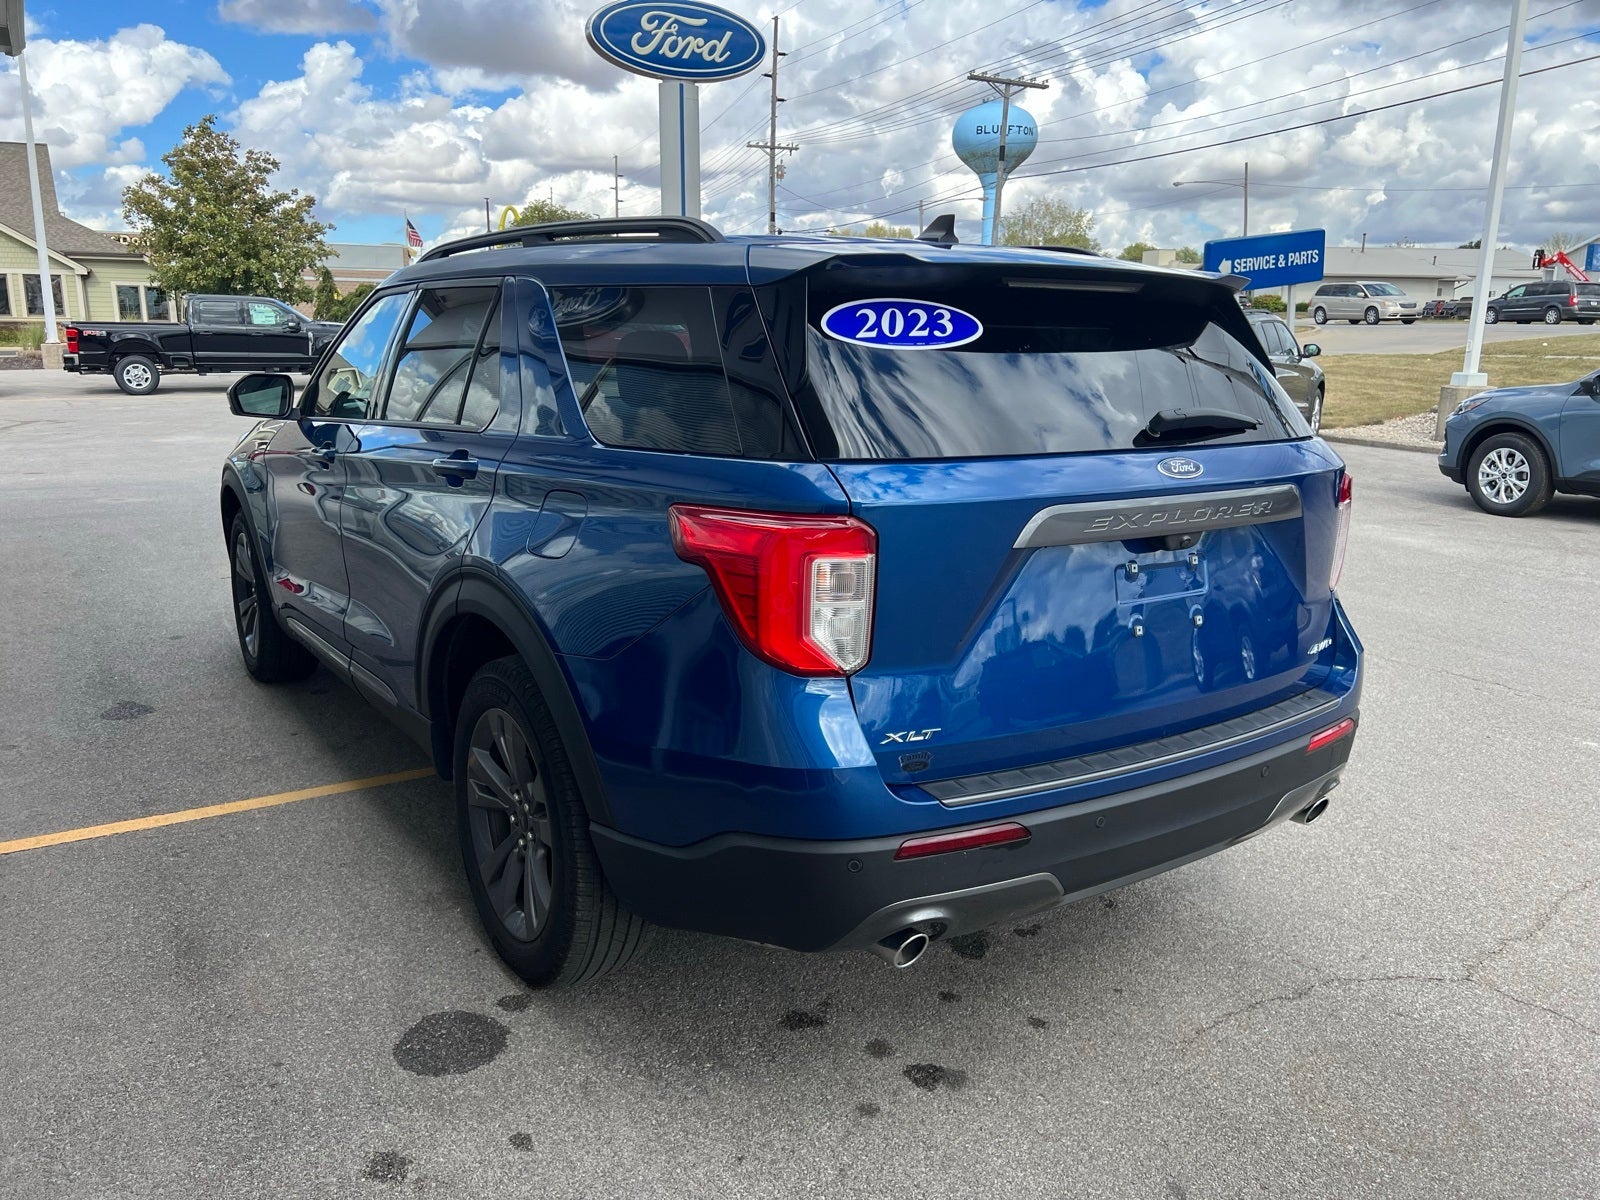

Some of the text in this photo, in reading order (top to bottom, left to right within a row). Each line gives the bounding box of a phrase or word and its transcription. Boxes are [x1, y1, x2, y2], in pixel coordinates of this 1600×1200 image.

[631, 11, 733, 63] Ford
[975, 124, 1034, 137] BLUFTON
[1233, 249, 1319, 273] SERVICE & PARTS
[855, 308, 954, 339] 2023
[1170, 459, 1196, 473] Ford
[1083, 500, 1273, 533] EXPLORER
[879, 728, 942, 745] XLT
